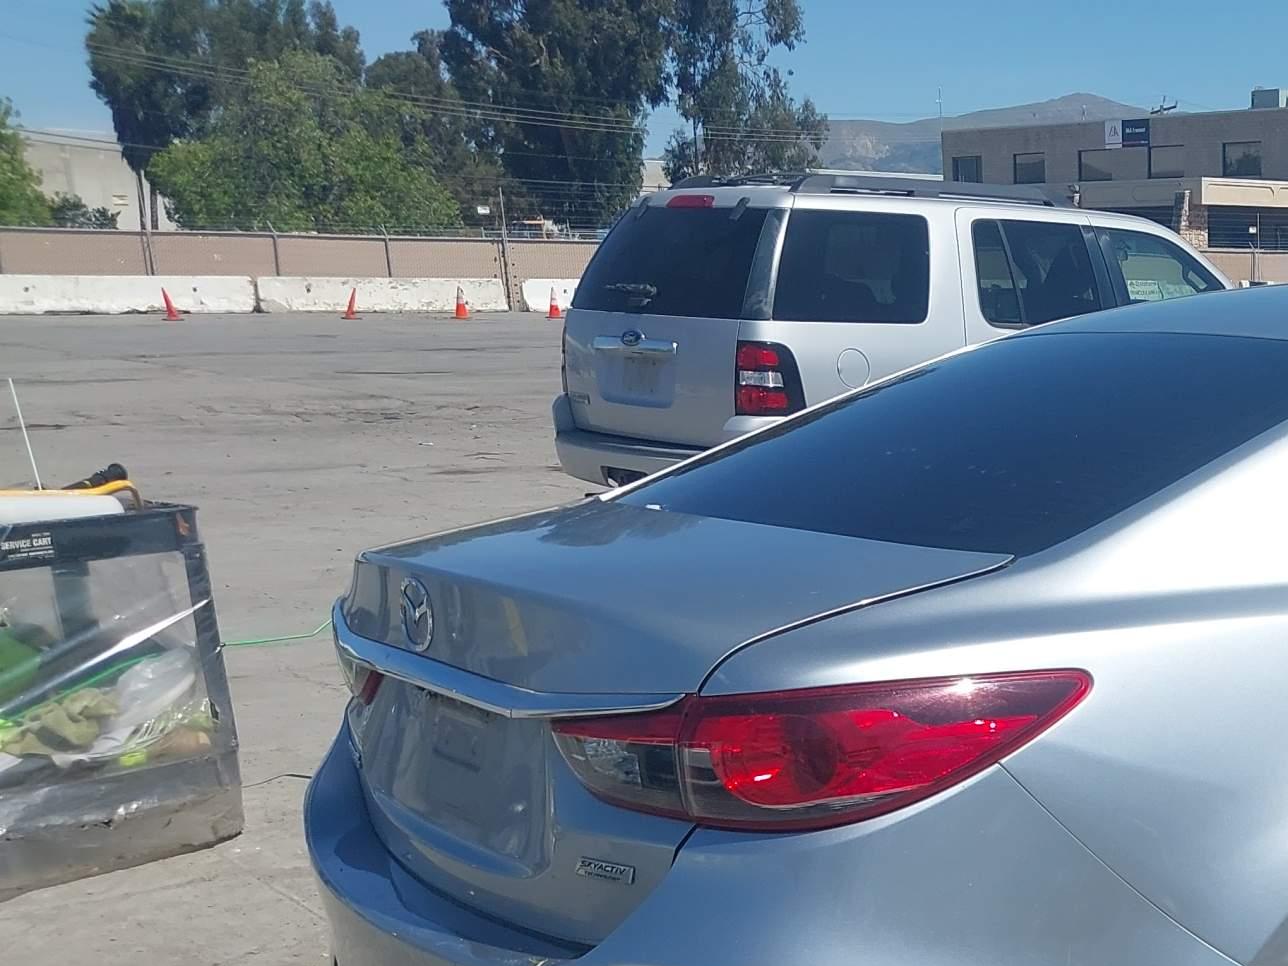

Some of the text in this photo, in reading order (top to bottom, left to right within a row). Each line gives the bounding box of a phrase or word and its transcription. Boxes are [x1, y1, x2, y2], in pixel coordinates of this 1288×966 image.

[1, 540, 32, 551] SERVICE
[32, 537, 51, 547] CART
[580, 860, 626, 875] SKYACTIV
